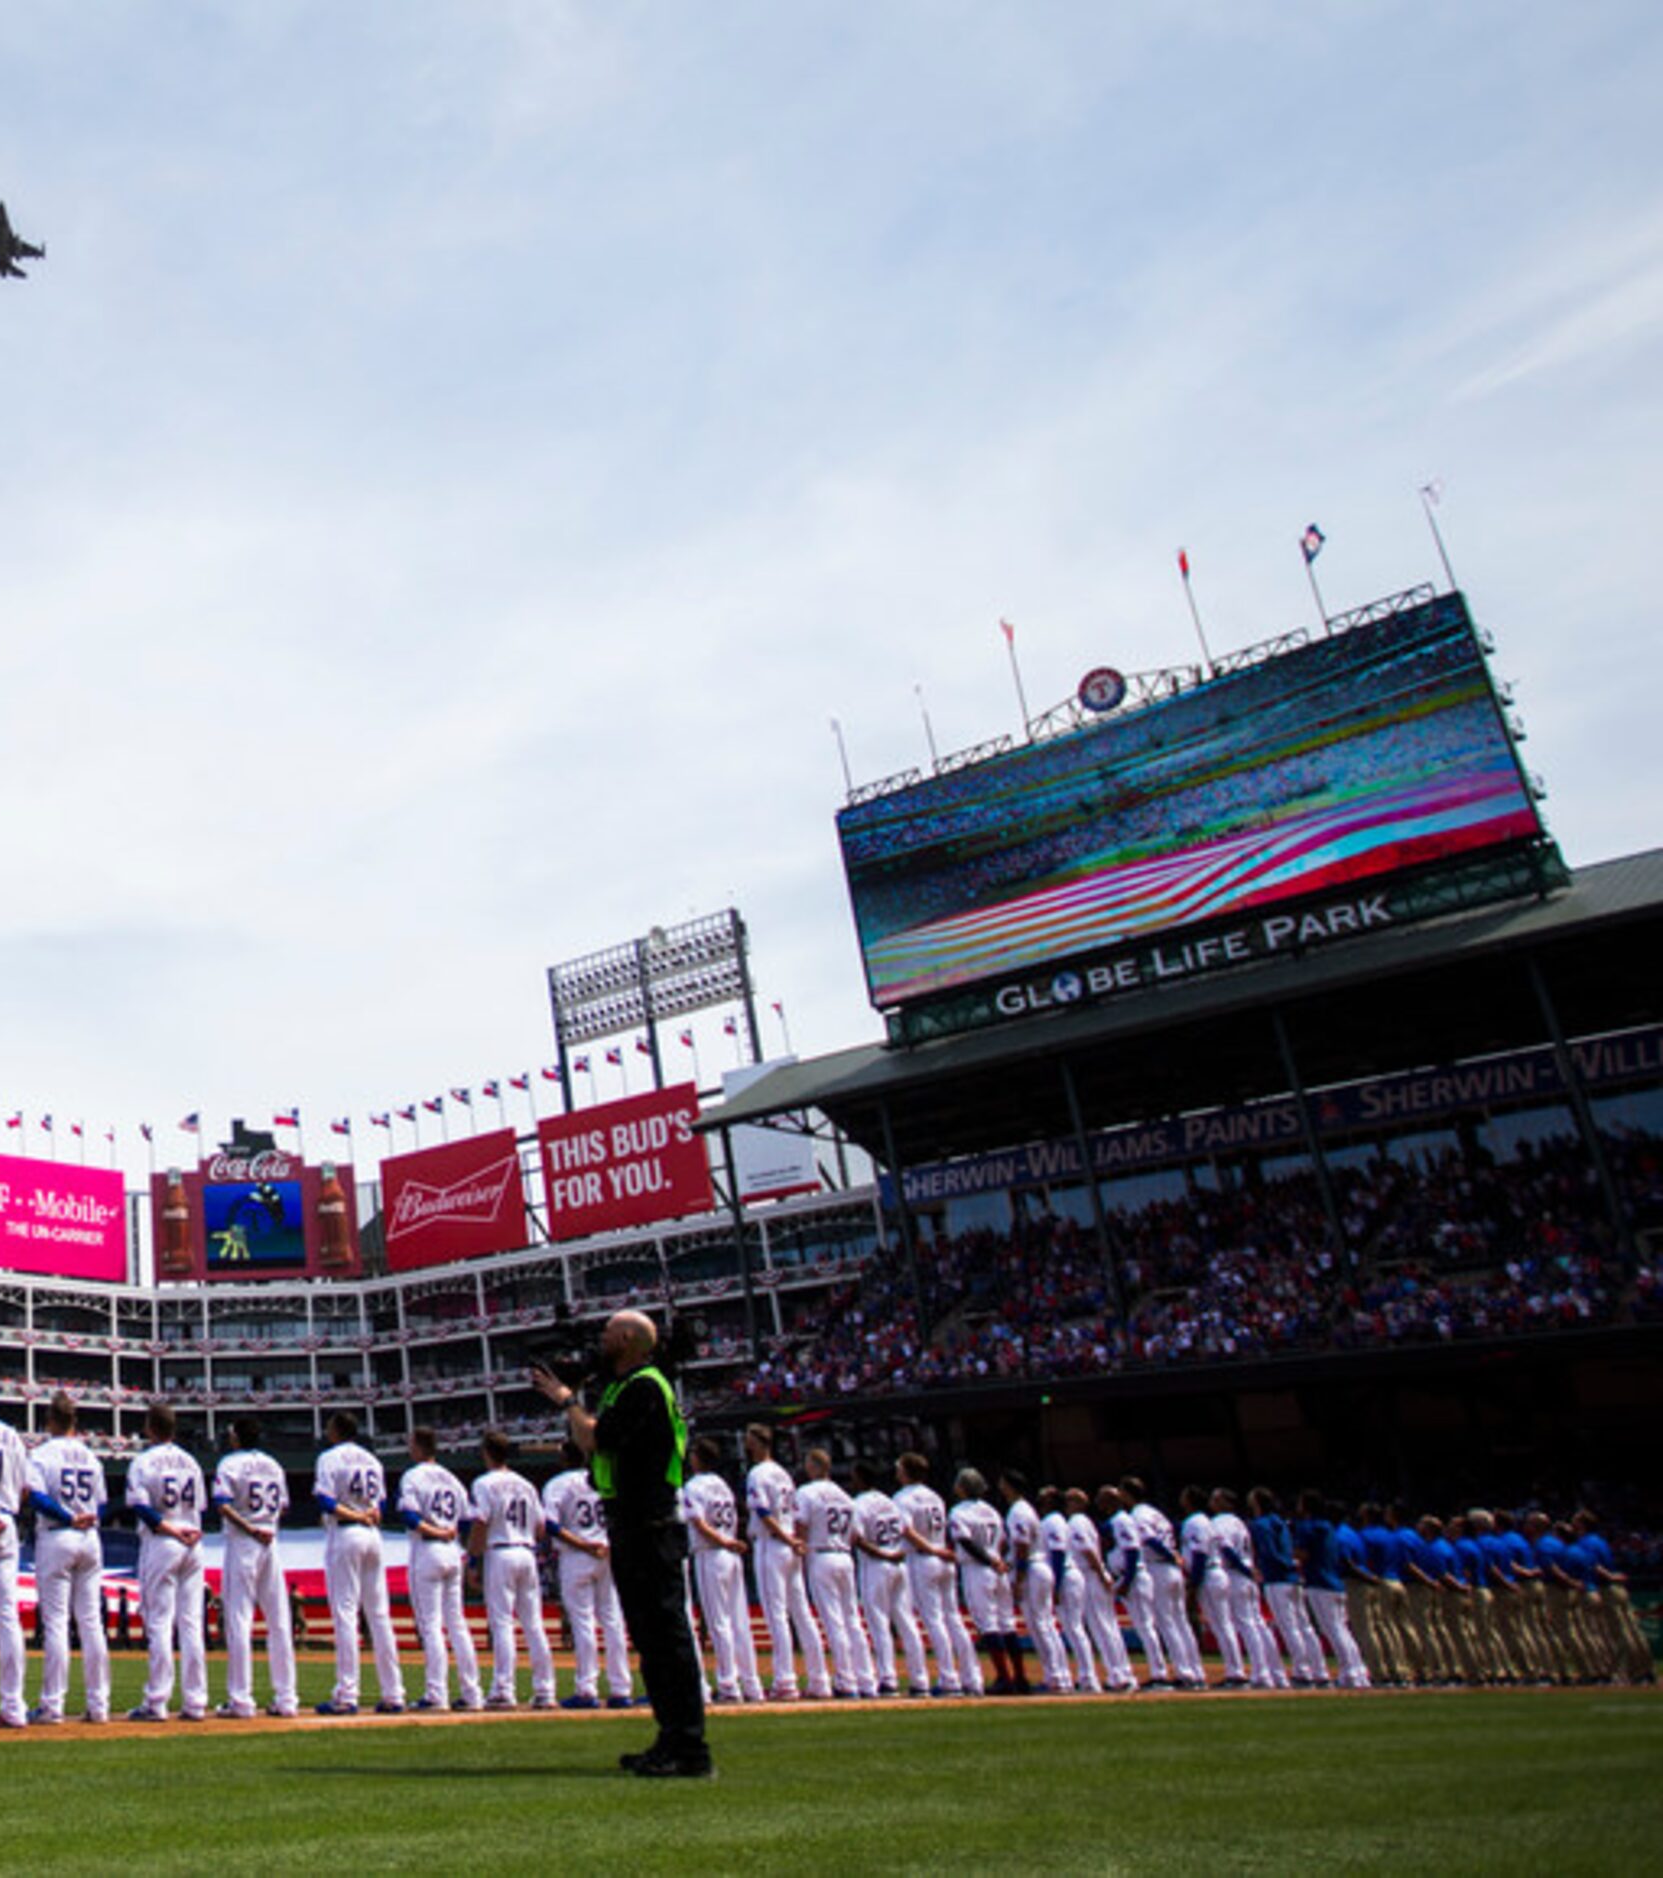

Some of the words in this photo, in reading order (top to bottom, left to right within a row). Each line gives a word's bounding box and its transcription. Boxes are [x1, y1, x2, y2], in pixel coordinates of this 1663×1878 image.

[995, 957, 1141, 1016] GLOBE
[1151, 930, 1252, 977] LIFE
[1262, 894, 1393, 951] PARK
[546, 1129, 608, 1172] THIS
[611, 1108, 694, 1159] BUD'S
[902, 1129, 1174, 1200] HERWIN-WILIAMS
[1184, 1106, 1301, 1151] PAINTS
[551, 1172, 605, 1213] FOR
[607, 1158, 673, 1200] YOU.
[396, 1183, 504, 1223] Budweiser
[5, 1219, 30, 1240] THE
[32, 1225, 105, 1246] UN-CARRIER
[60, 1468, 94, 1503] 55
[162, 1476, 196, 1509] 54
[248, 1481, 281, 1513] 53
[348, 1468, 381, 1500] 46
[431, 1489, 457, 1522] 43
[505, 1498, 528, 1530] 41
[826, 1506, 853, 1535] 27
[875, 1518, 902, 1546] 25
